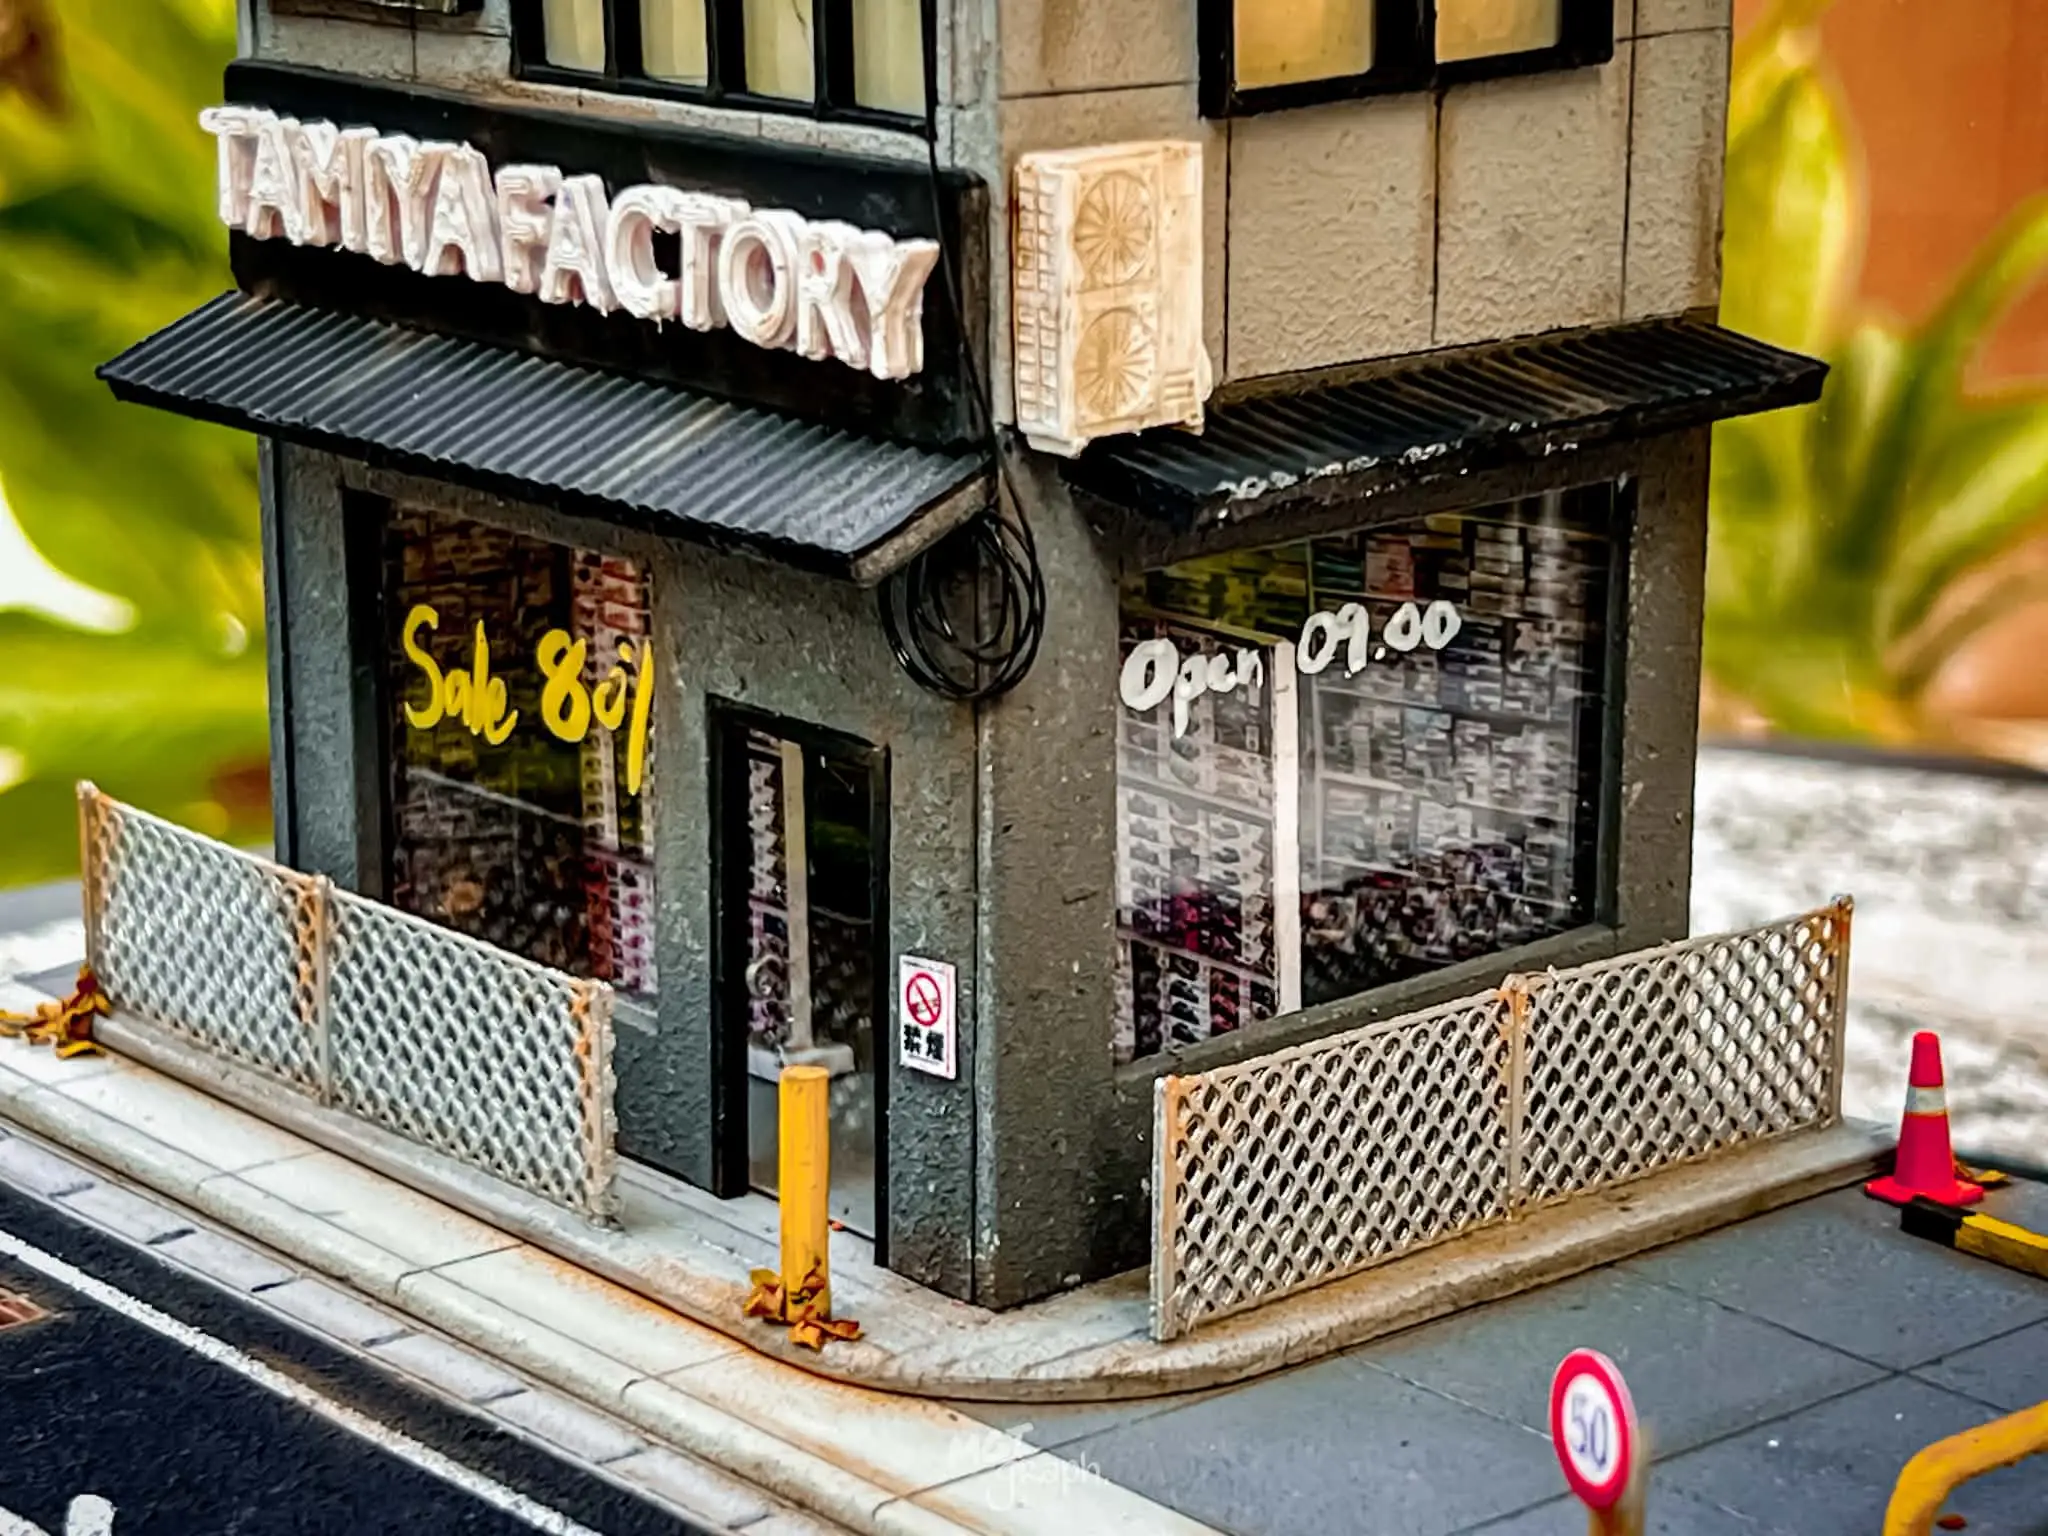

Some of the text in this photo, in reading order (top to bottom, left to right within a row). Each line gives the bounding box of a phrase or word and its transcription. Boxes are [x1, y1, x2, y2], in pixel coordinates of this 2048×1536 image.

[404, 604, 519, 745] Sale
[1119, 600, 1462, 738] Open 09.00
[1570, 1392, 1609, 1472] 50
